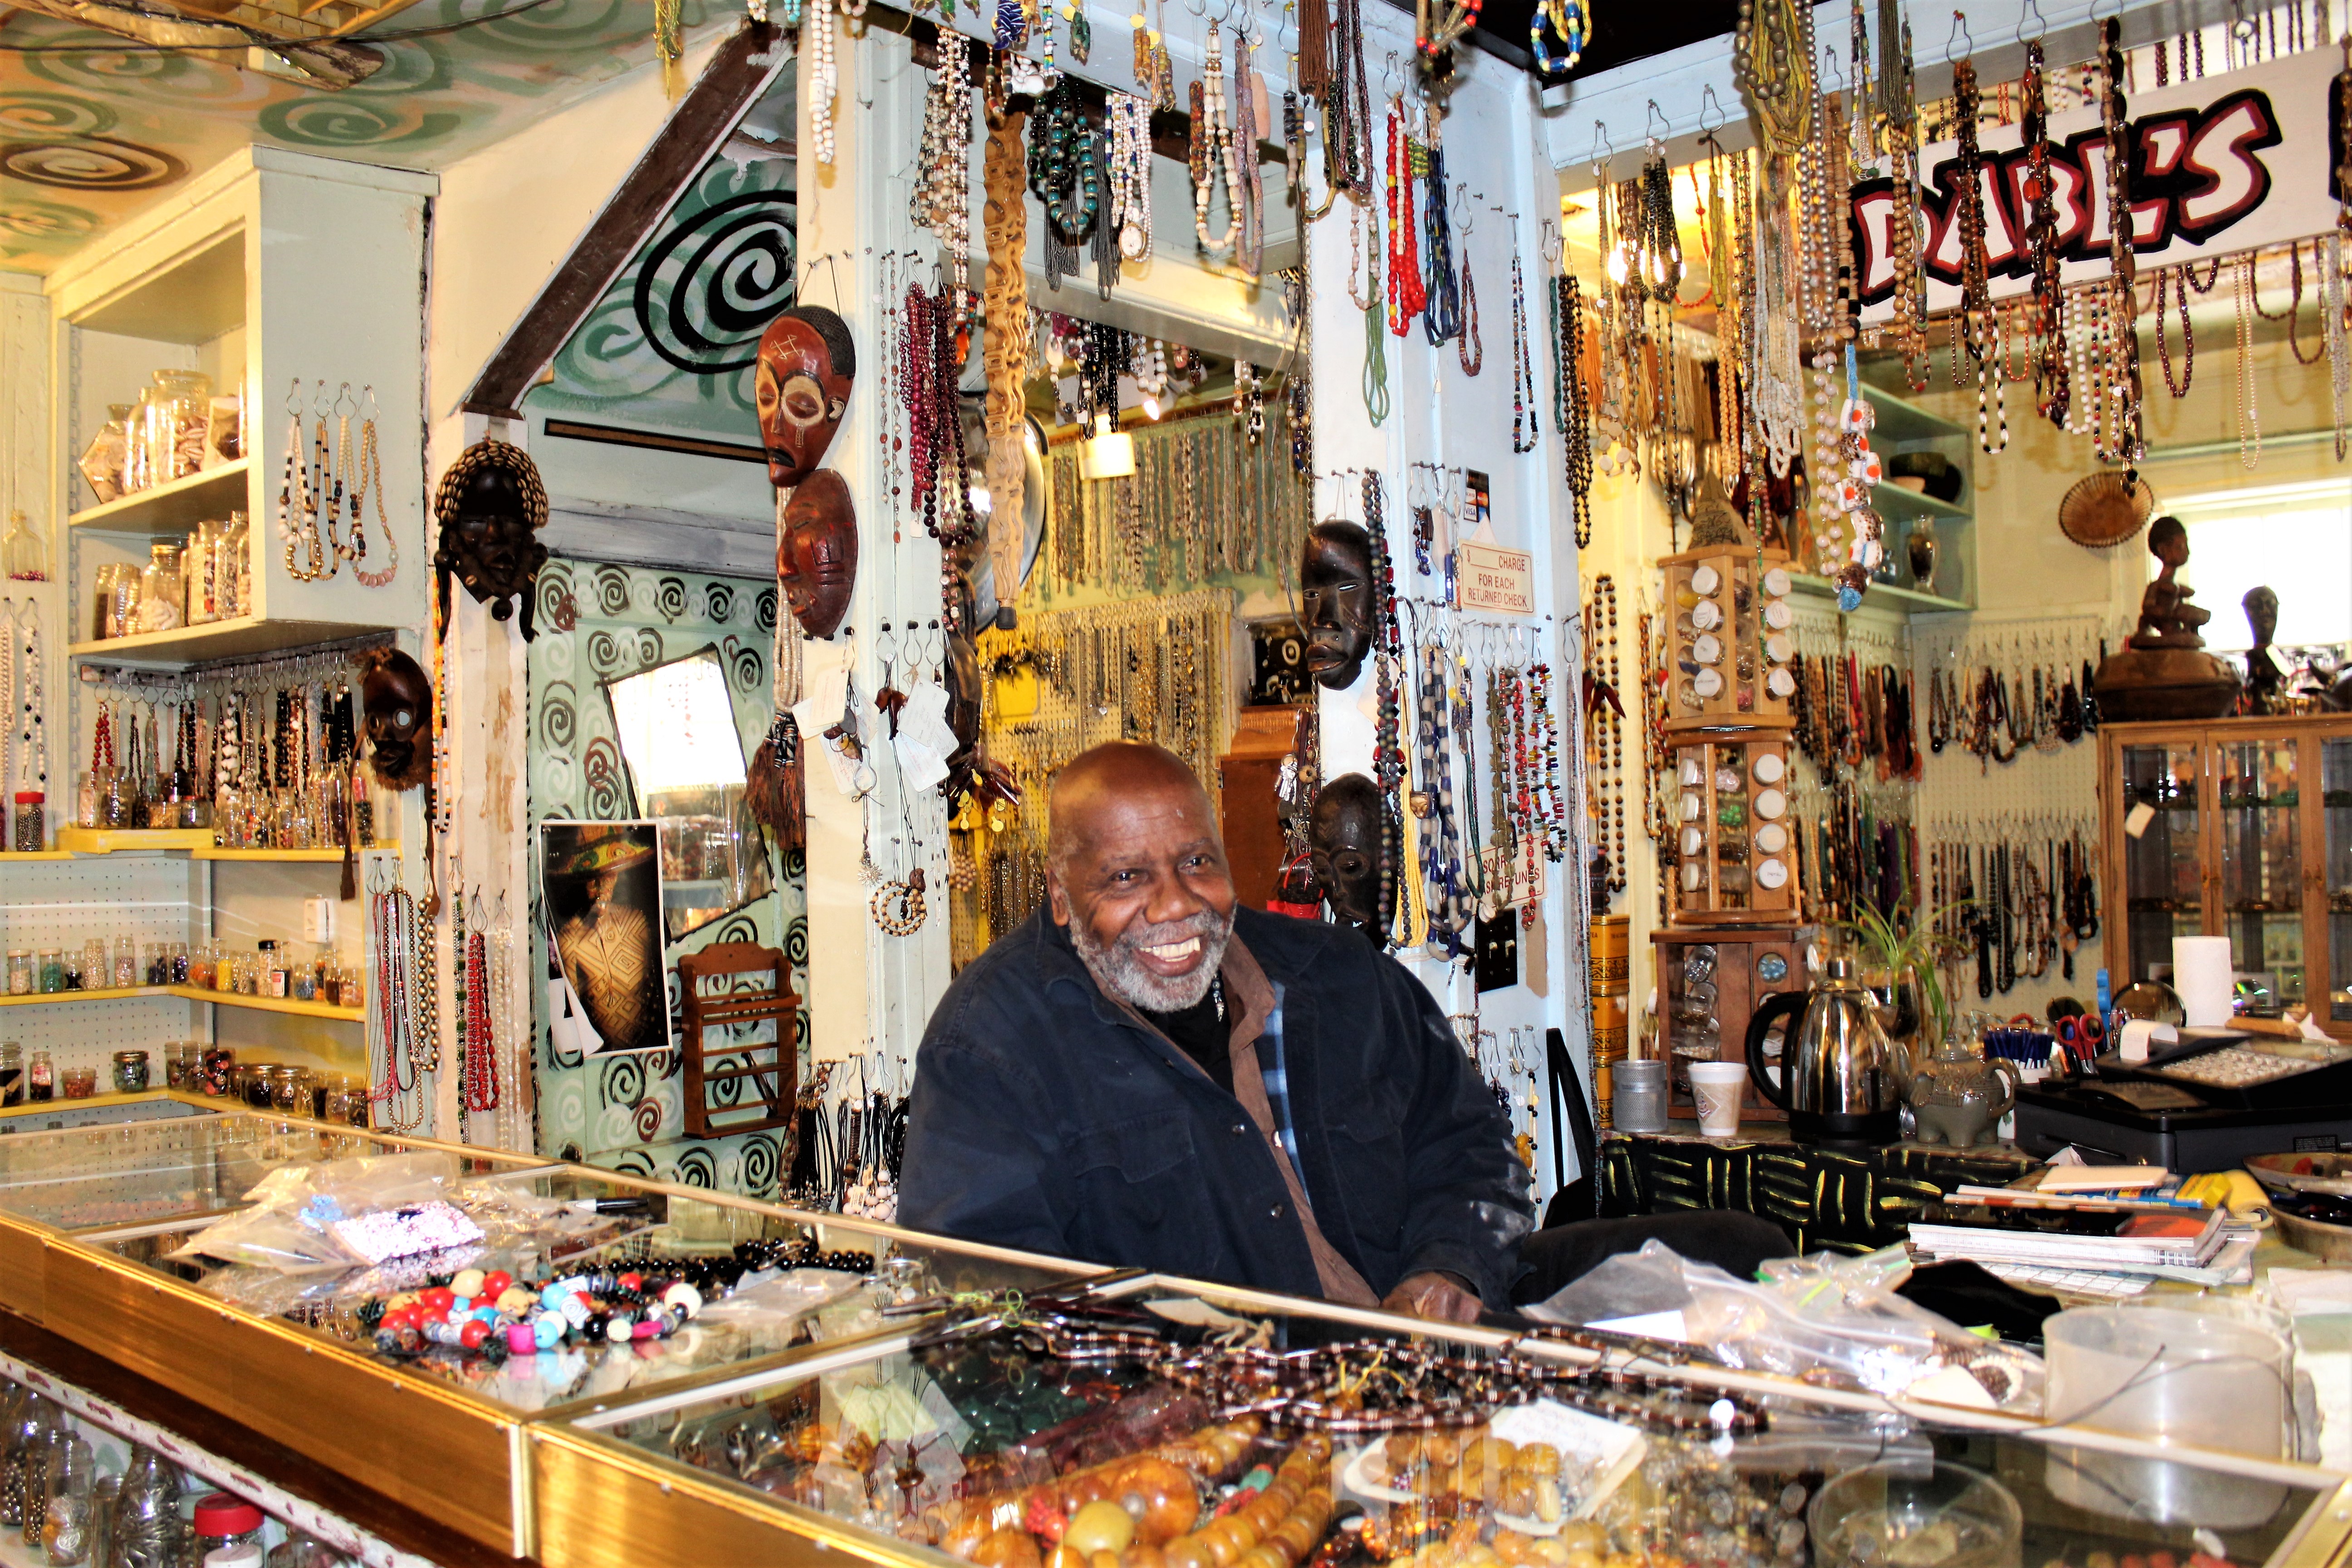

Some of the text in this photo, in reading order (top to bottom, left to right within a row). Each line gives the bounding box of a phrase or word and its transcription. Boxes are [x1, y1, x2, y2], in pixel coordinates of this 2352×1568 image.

[1850, 88, 2282, 305] DABL'S
[1465, 508, 1476, 516] VISA
[1499, 555, 1525, 571] CHARGE
[1478, 573, 1514, 590] FOR EACH
[1468, 588, 1528, 607] RETURNED CHECK
[1483, 855, 1514, 873] SORR
